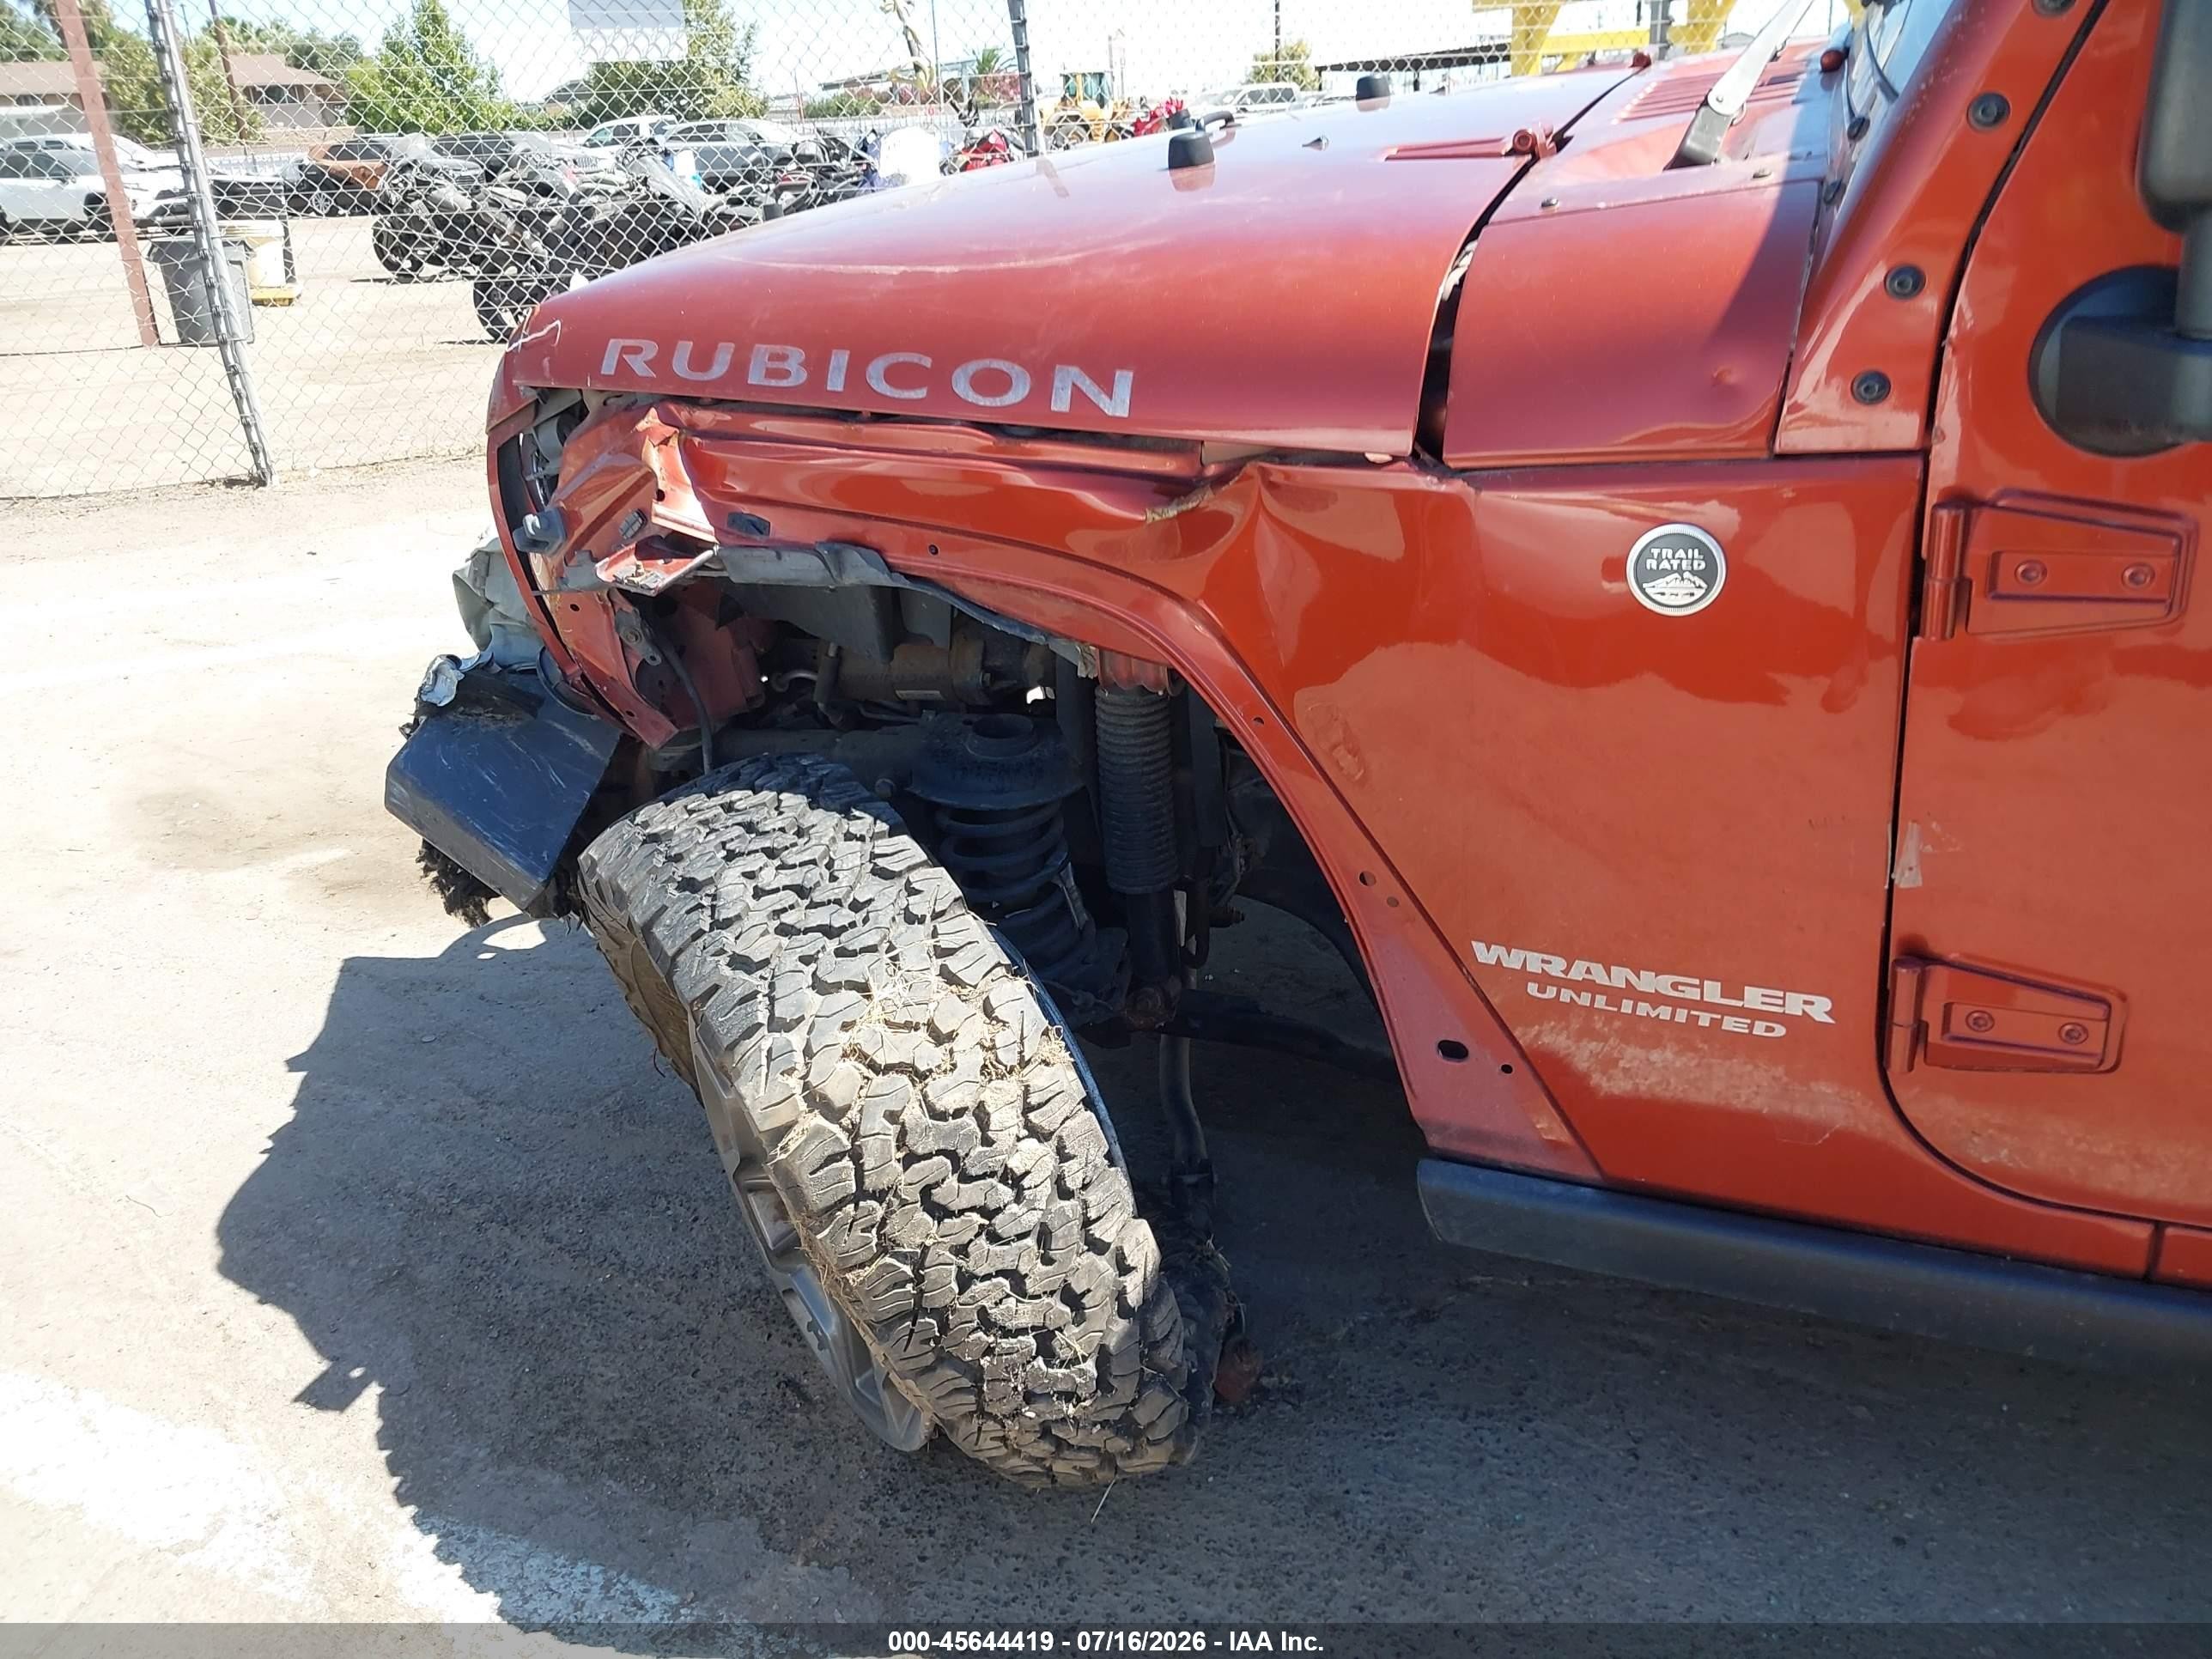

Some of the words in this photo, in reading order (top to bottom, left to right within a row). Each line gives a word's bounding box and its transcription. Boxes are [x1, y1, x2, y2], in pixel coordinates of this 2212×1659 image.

[600, 337, 1133, 418] RUBICON
[1645, 558, 1706, 571] RATED
[1650, 548, 1704, 560] TRAIL
[1470, 940, 1836, 1024] WRANGLER
[1526, 981, 1787, 1037] UNLIMITED
